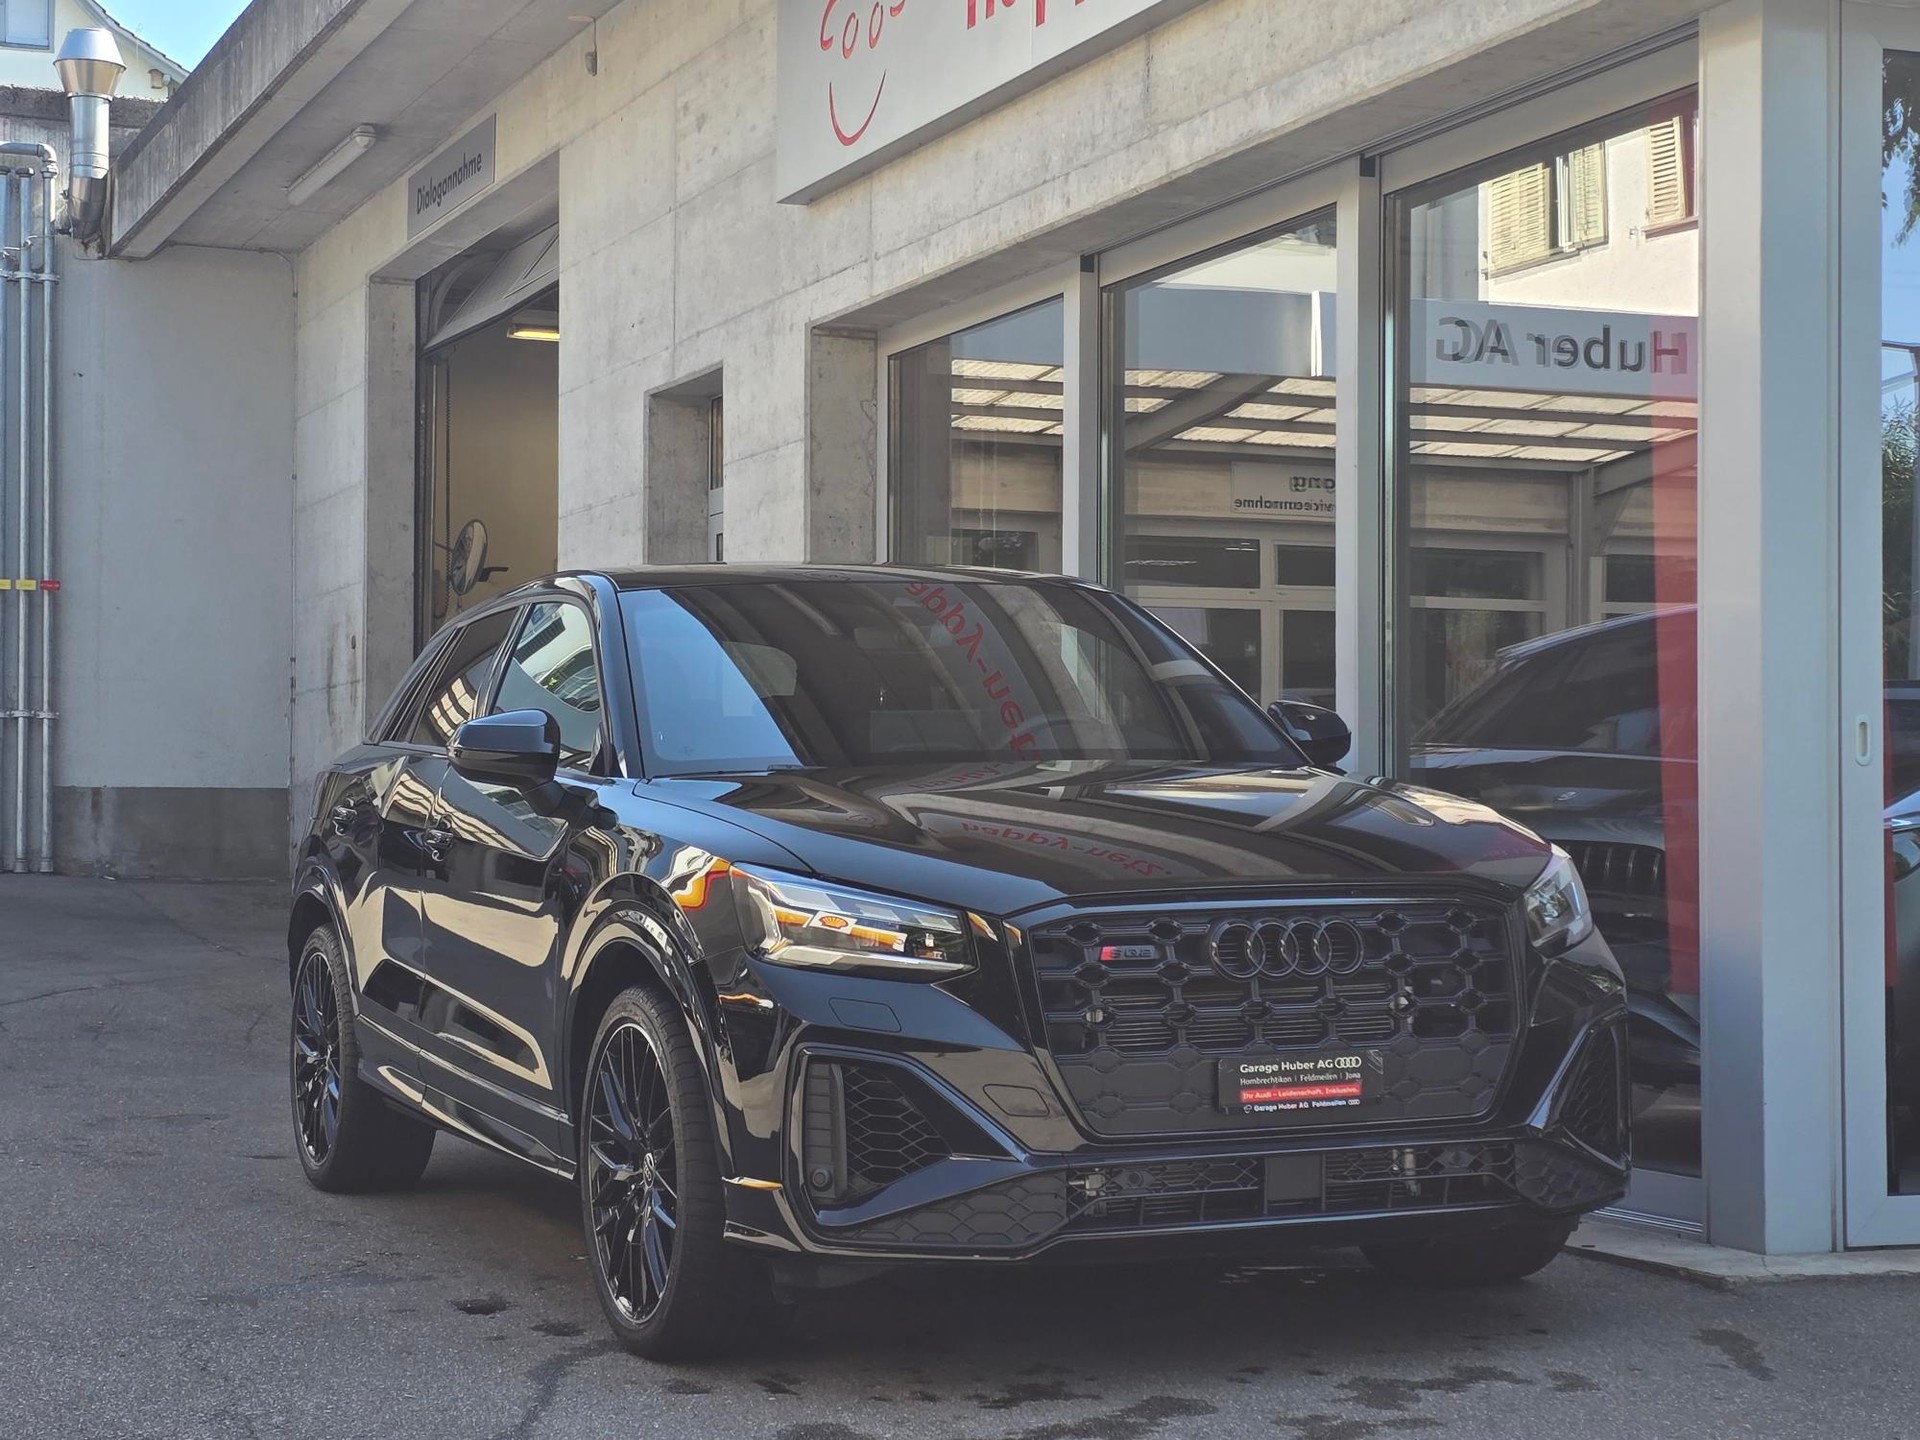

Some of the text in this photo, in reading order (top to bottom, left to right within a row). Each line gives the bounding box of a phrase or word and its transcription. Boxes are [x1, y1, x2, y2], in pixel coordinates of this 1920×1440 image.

[416, 152, 482, 214] Dialogannahme
[1240, 1059, 1334, 1074] Garage Huber AG
[1240, 1076, 1293, 1086] Hombrechtikon
[1300, 1073, 1338, 1082] Feldmeilen
[1345, 1072, 1361, 1080] Jona
[1243, 1092, 1254, 1100] Ihr
[1255, 1091, 1271, 1099] Audi
[1254, 1105, 1277, 1113] Garage
[1298, 1101, 1309, 1109] AG
